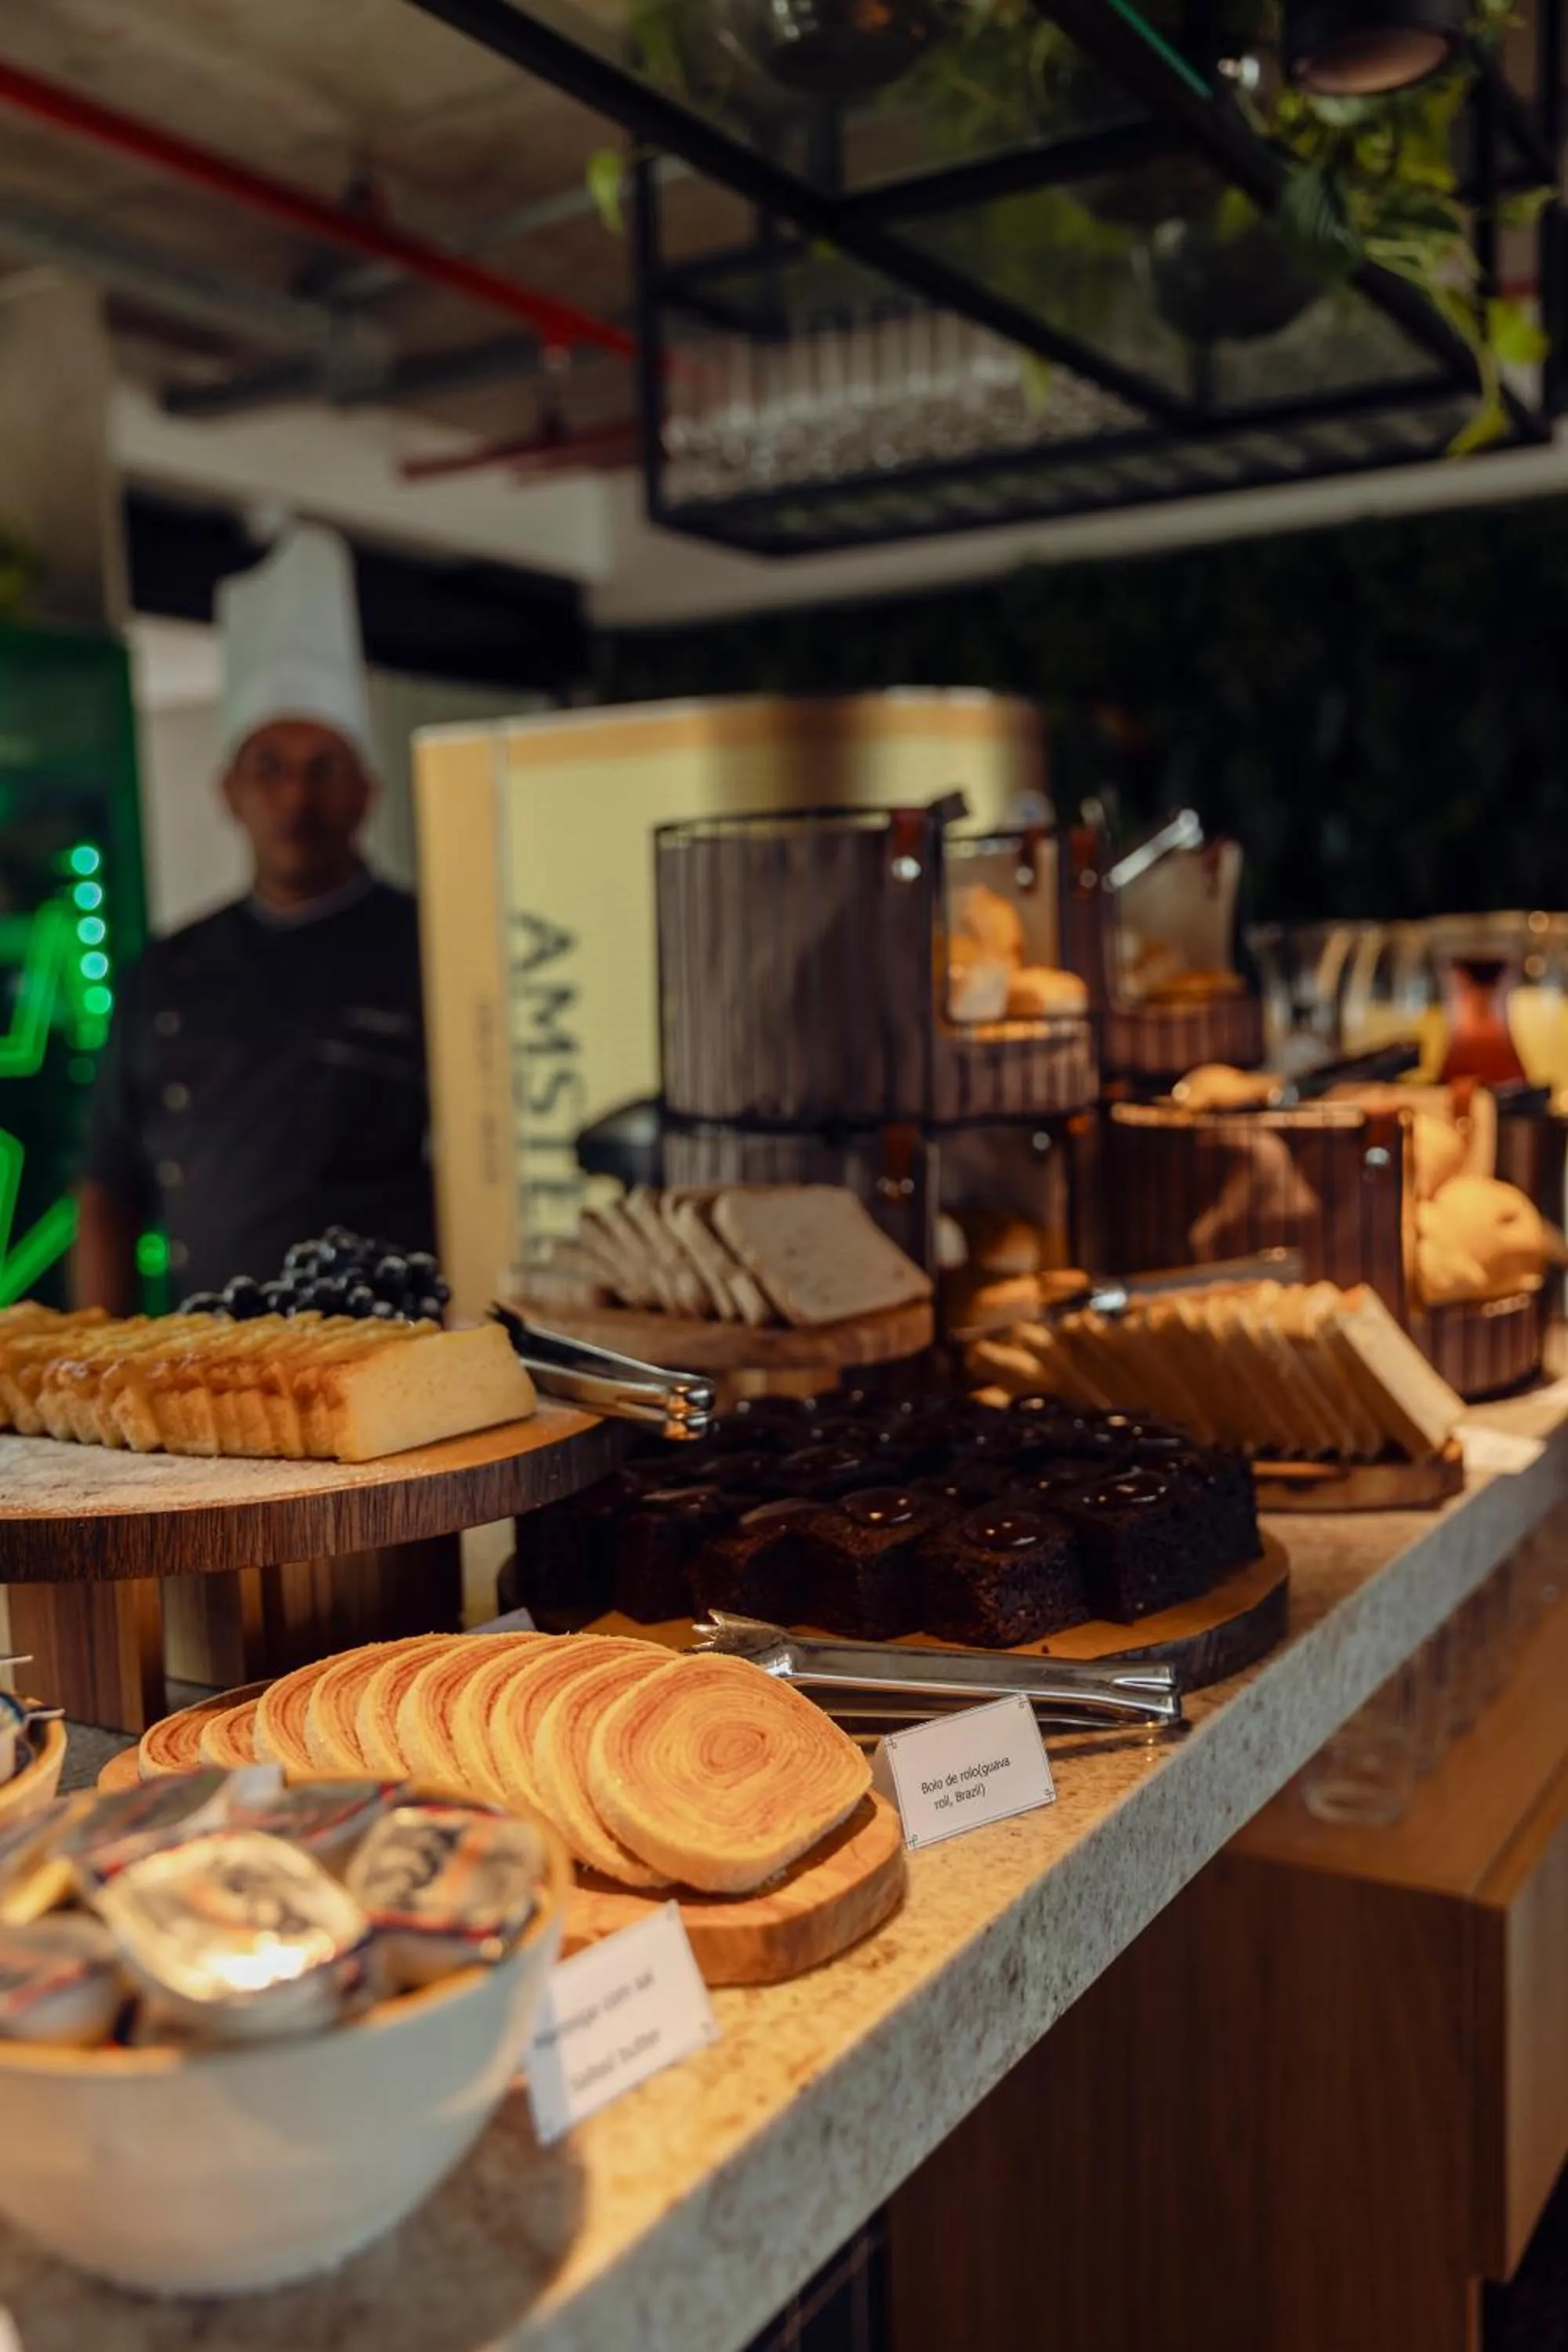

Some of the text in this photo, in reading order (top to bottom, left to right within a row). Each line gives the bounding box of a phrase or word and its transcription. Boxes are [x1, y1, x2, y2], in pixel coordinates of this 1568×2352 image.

[921, 1780, 943, 1795] Bolo
[946, 1773, 958, 1786] de
[956, 1783, 985, 1802] Brazil)
